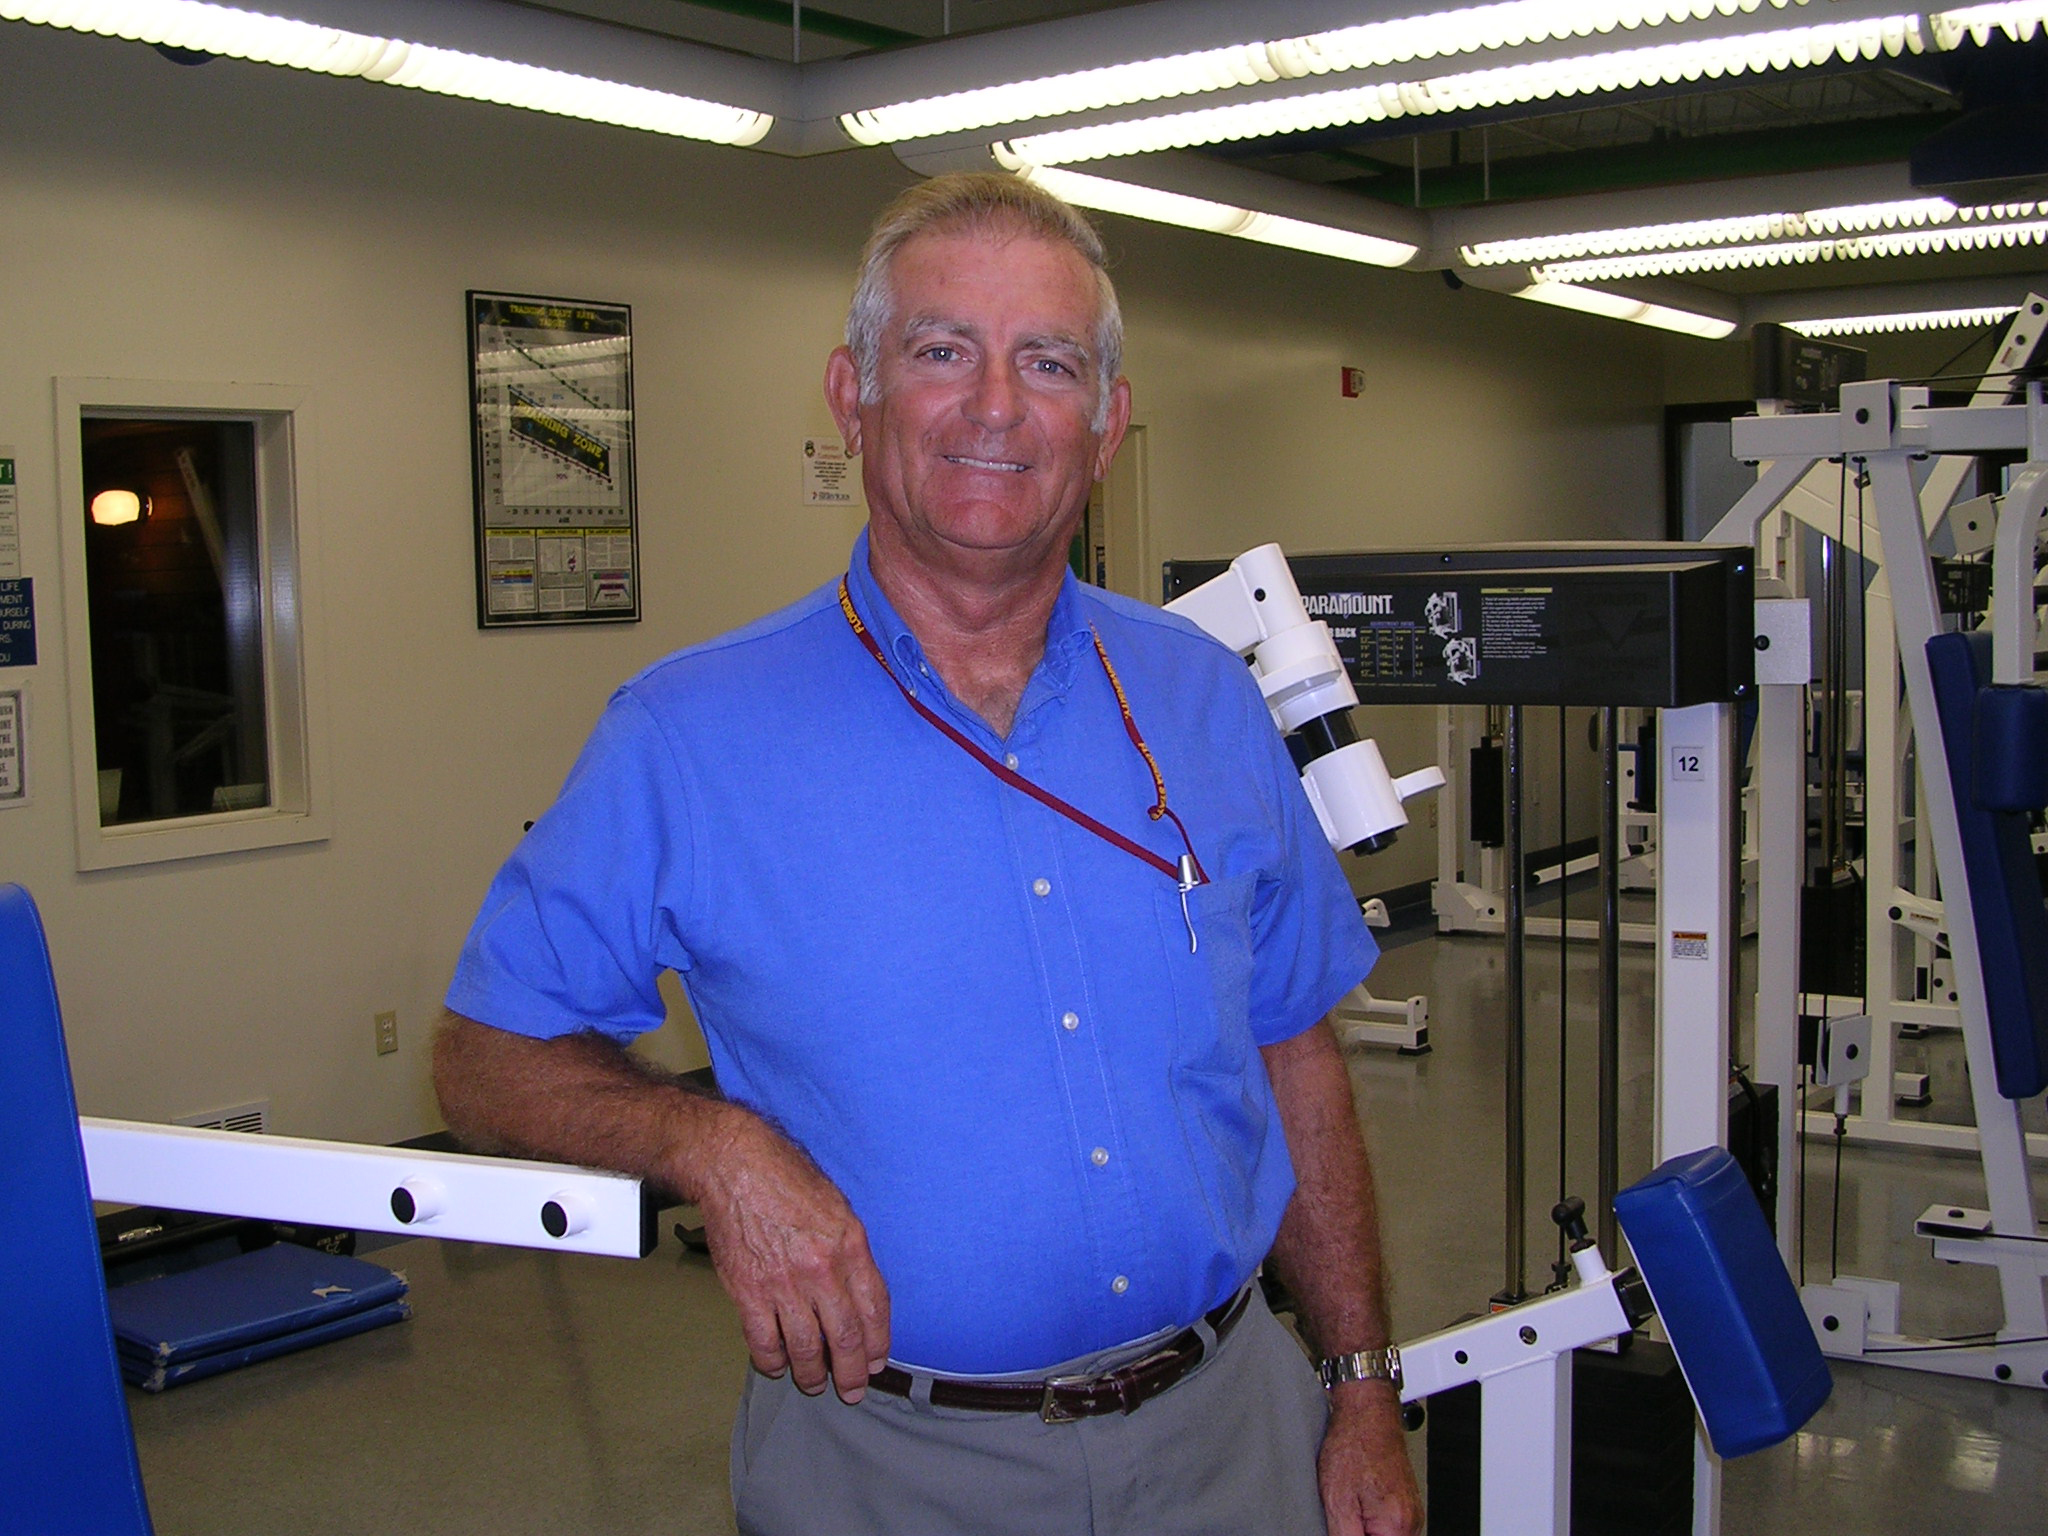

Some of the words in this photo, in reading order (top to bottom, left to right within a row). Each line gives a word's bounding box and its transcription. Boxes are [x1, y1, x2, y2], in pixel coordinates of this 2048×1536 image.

[573, 434, 604, 458] ZONE
[1, 581, 20, 592] LIFE
[1301, 593, 1393, 615] PARAMOUNT
[3, 620, 32, 630] DURING
[1335, 627, 1357, 638] BACK
[1678, 756, 1699, 772] 12
